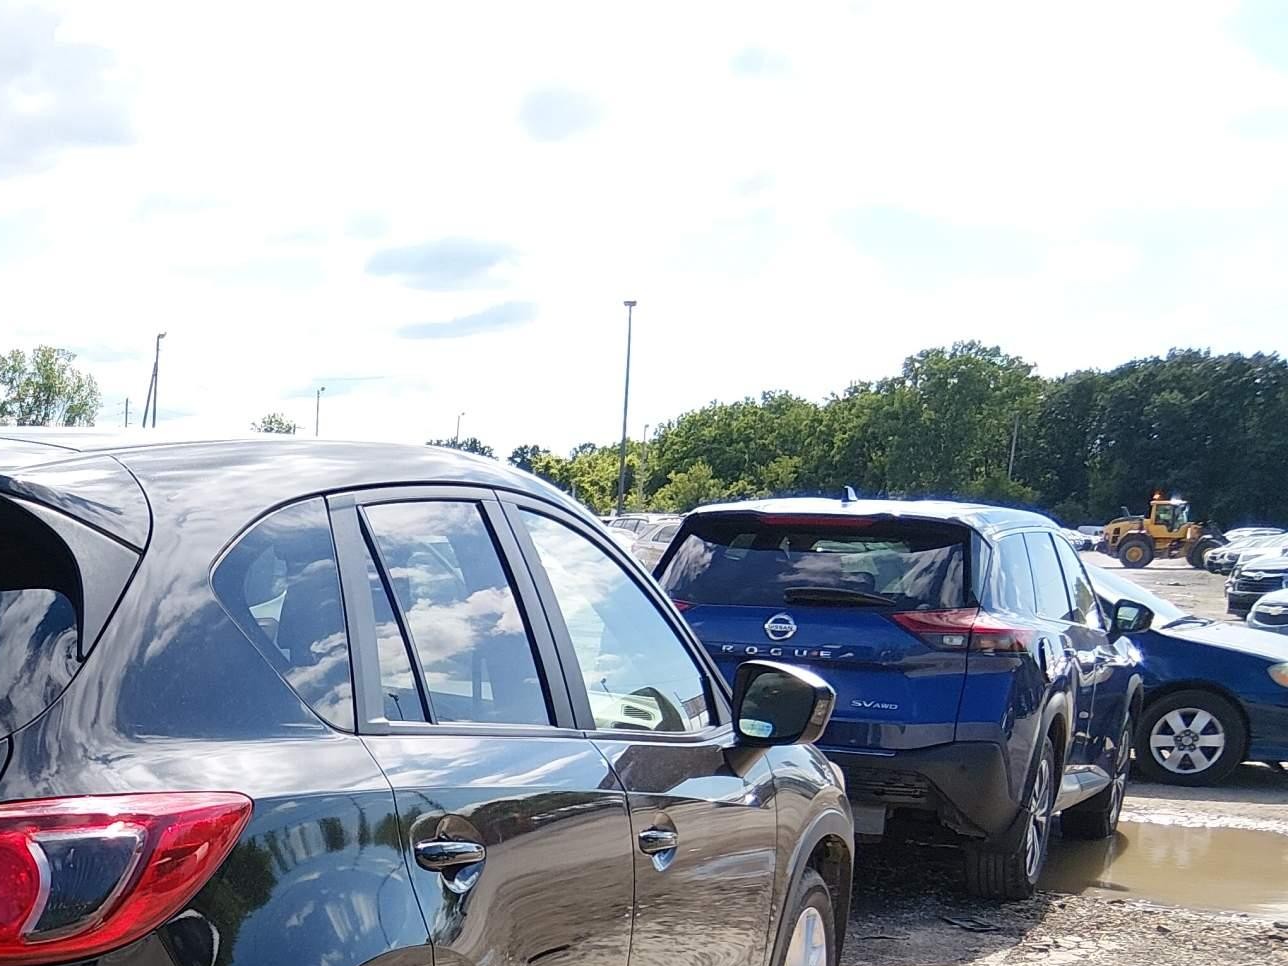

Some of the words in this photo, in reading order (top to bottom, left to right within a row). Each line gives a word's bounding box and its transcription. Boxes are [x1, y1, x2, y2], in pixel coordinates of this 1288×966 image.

[721, 644, 832, 659] ROGUE
[851, 699, 875, 708] SV
[872, 702, 899, 710] AWD
